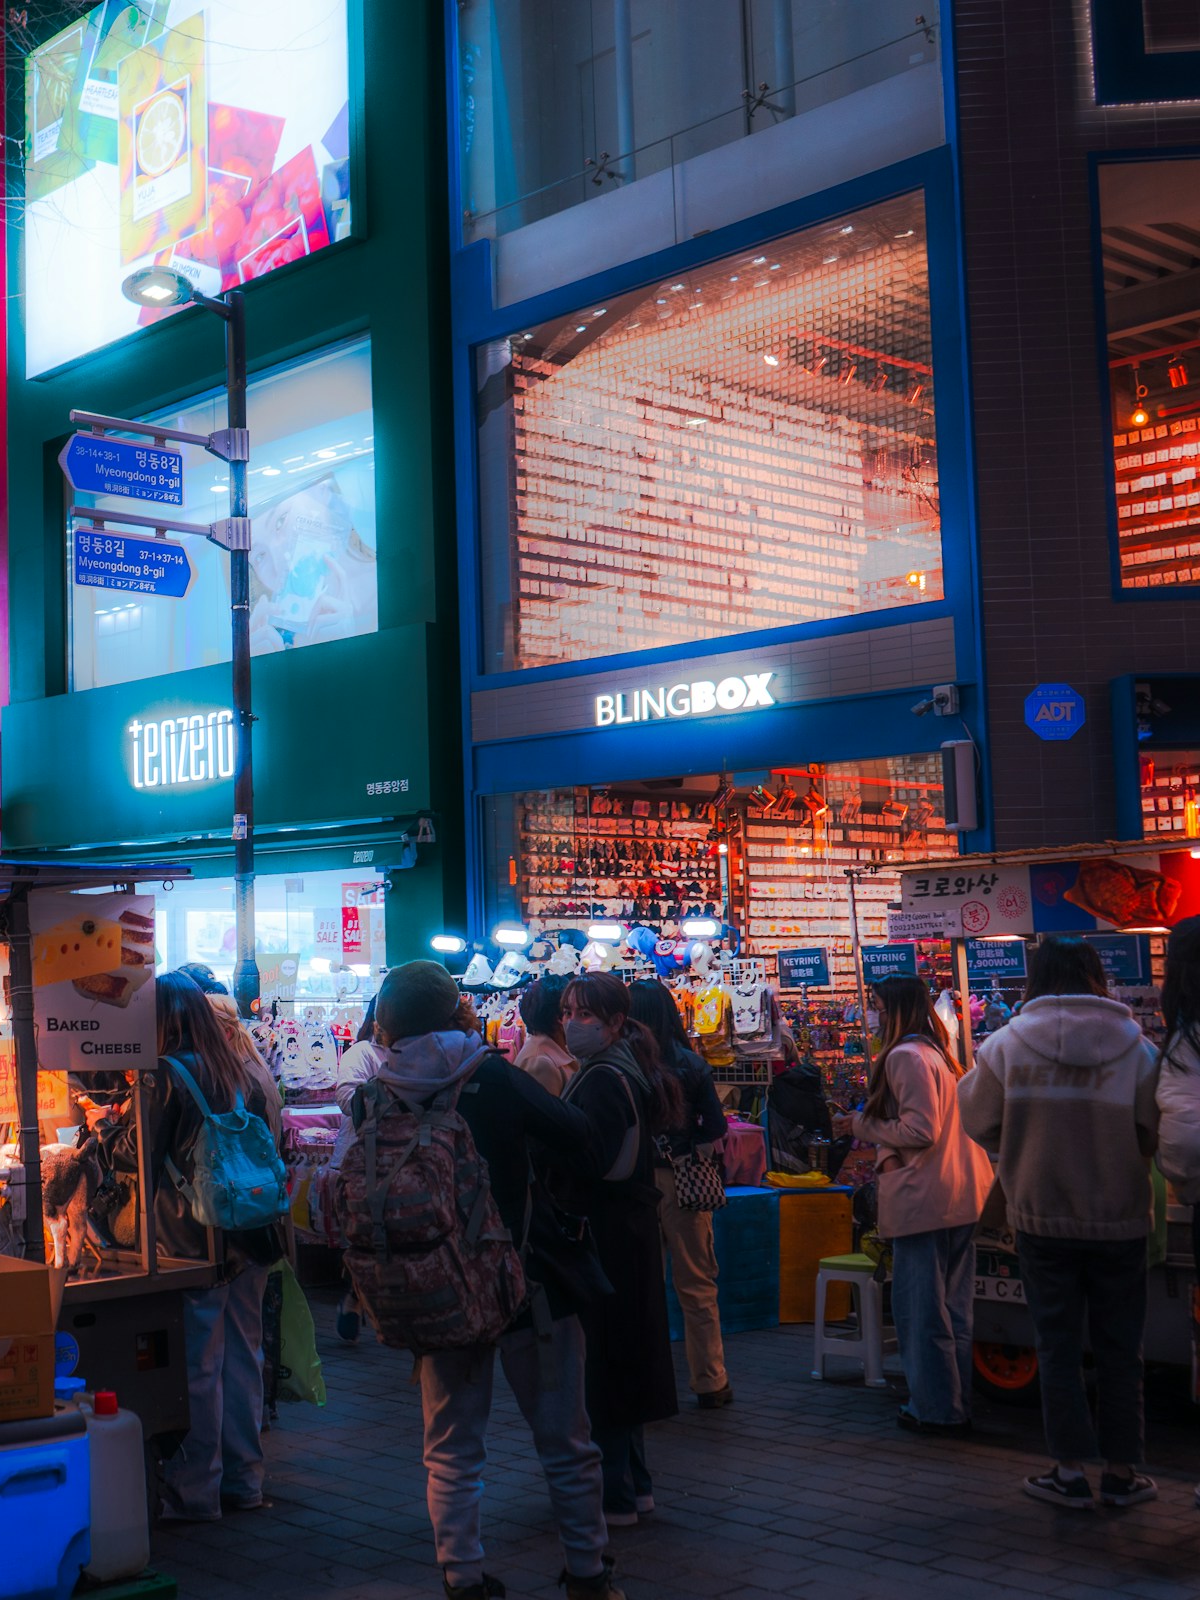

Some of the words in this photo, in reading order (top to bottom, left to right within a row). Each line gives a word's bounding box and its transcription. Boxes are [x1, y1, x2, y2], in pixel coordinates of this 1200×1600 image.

[135, 450, 179, 474] 명동8길
[95, 463, 157, 485] Myeongdong
[159, 474, 180, 489] 8-gil
[78, 535, 125, 558] 명동8길
[78, 556, 141, 577] Myeongdong
[143, 565, 165, 579] 8-gil
[595, 672, 775, 726] BLINGBOX
[1034, 702, 1076, 722] ADT
[129, 710, 235, 788] tenzero
[366, 779, 409, 796] 명동중앙점
[910, 874, 999, 898] 크로와상
[316, 931, 338, 943] SALE
[320, 921, 336, 930] BIG
[783, 955, 820, 967] KEYRING
[863, 953, 906, 963] KEYRING
